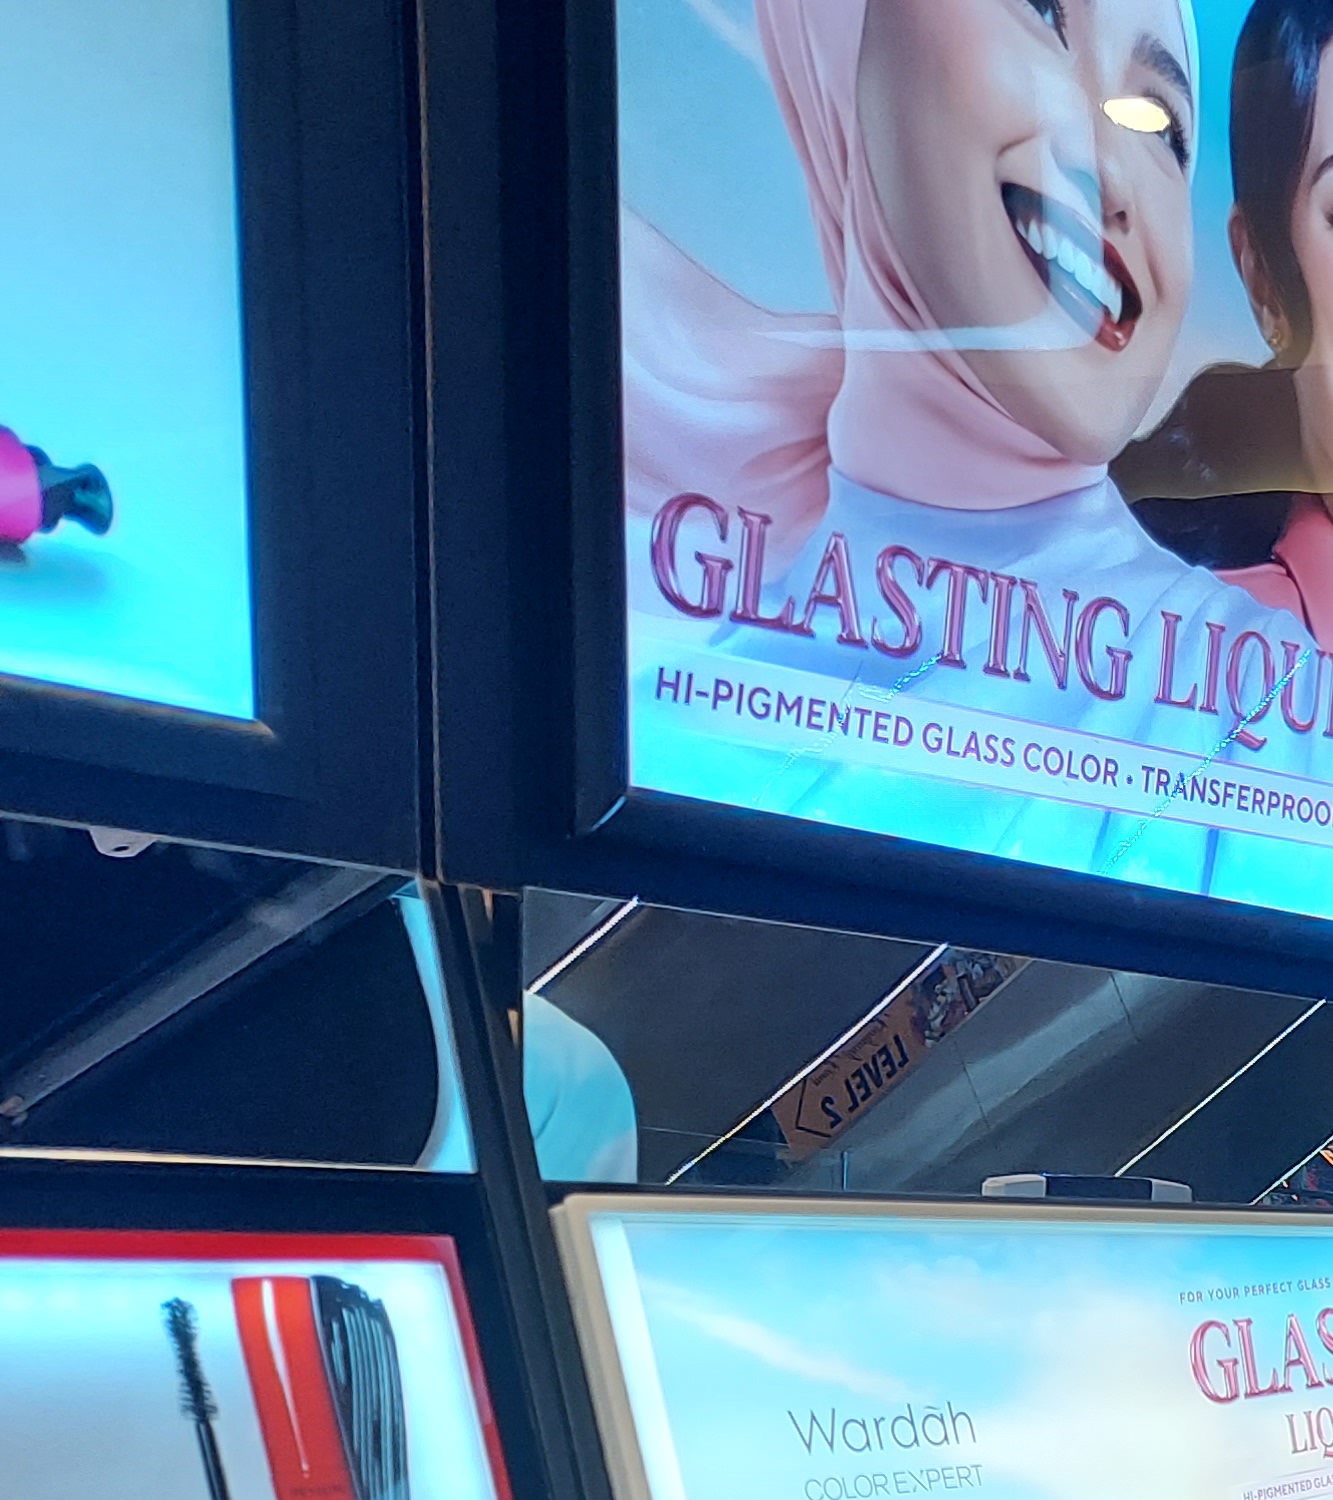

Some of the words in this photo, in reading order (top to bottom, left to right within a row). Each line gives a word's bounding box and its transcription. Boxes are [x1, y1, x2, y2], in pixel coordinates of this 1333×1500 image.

[650, 492, 1133, 702] GLASTING
[655, 666, 913, 747] HI-PIGMENTED
[921, 723, 1015, 768] GLASS
[1023, 743, 1118, 788] COLOR
[1180, 1290, 1203, 1304] FOR
[1208, 1287, 1240, 1301] YOUR
[1244, 1281, 1292, 1297] PERFECT
[1297, 1276, 1331, 1292] GLASS
[893, 1465, 983, 1494] EXPERT
